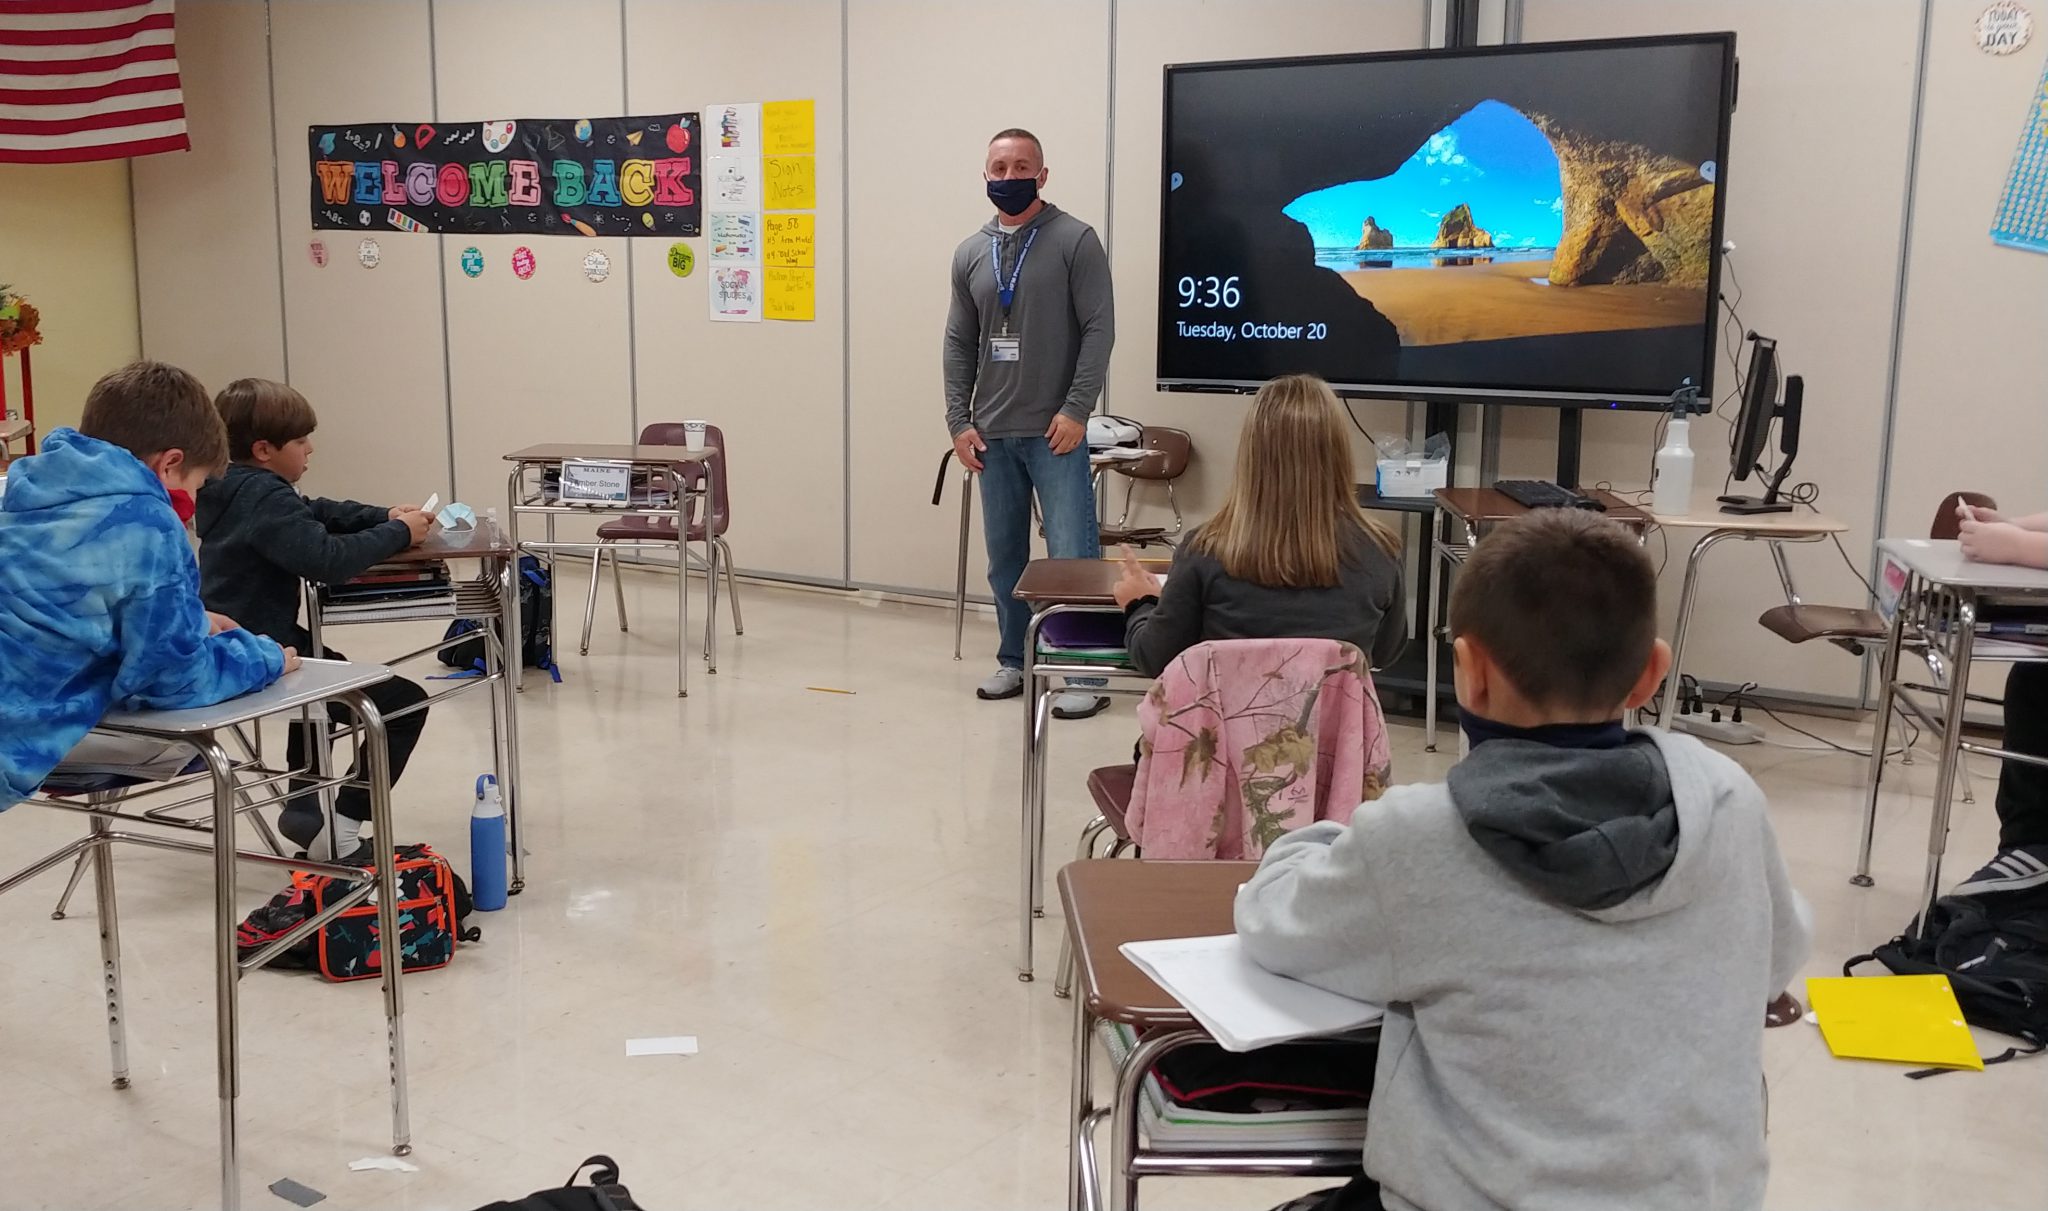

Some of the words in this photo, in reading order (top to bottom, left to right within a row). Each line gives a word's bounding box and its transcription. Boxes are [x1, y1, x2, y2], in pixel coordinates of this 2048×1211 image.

[1984, 32, 2017, 46] DAY
[316, 160, 541, 207] WELCOME
[552, 157, 694, 207] BACK
[771, 182, 804, 200] Notes
[767, 219, 782, 235] Page
[673, 257, 686, 270] BIG
[718, 291, 747, 300] STUDIES
[1178, 276, 1240, 308] 9:36
[1177, 321, 1237, 341] Tuesday,
[1241, 322, 1303, 339] October
[1307, 323, 1327, 340] 20
